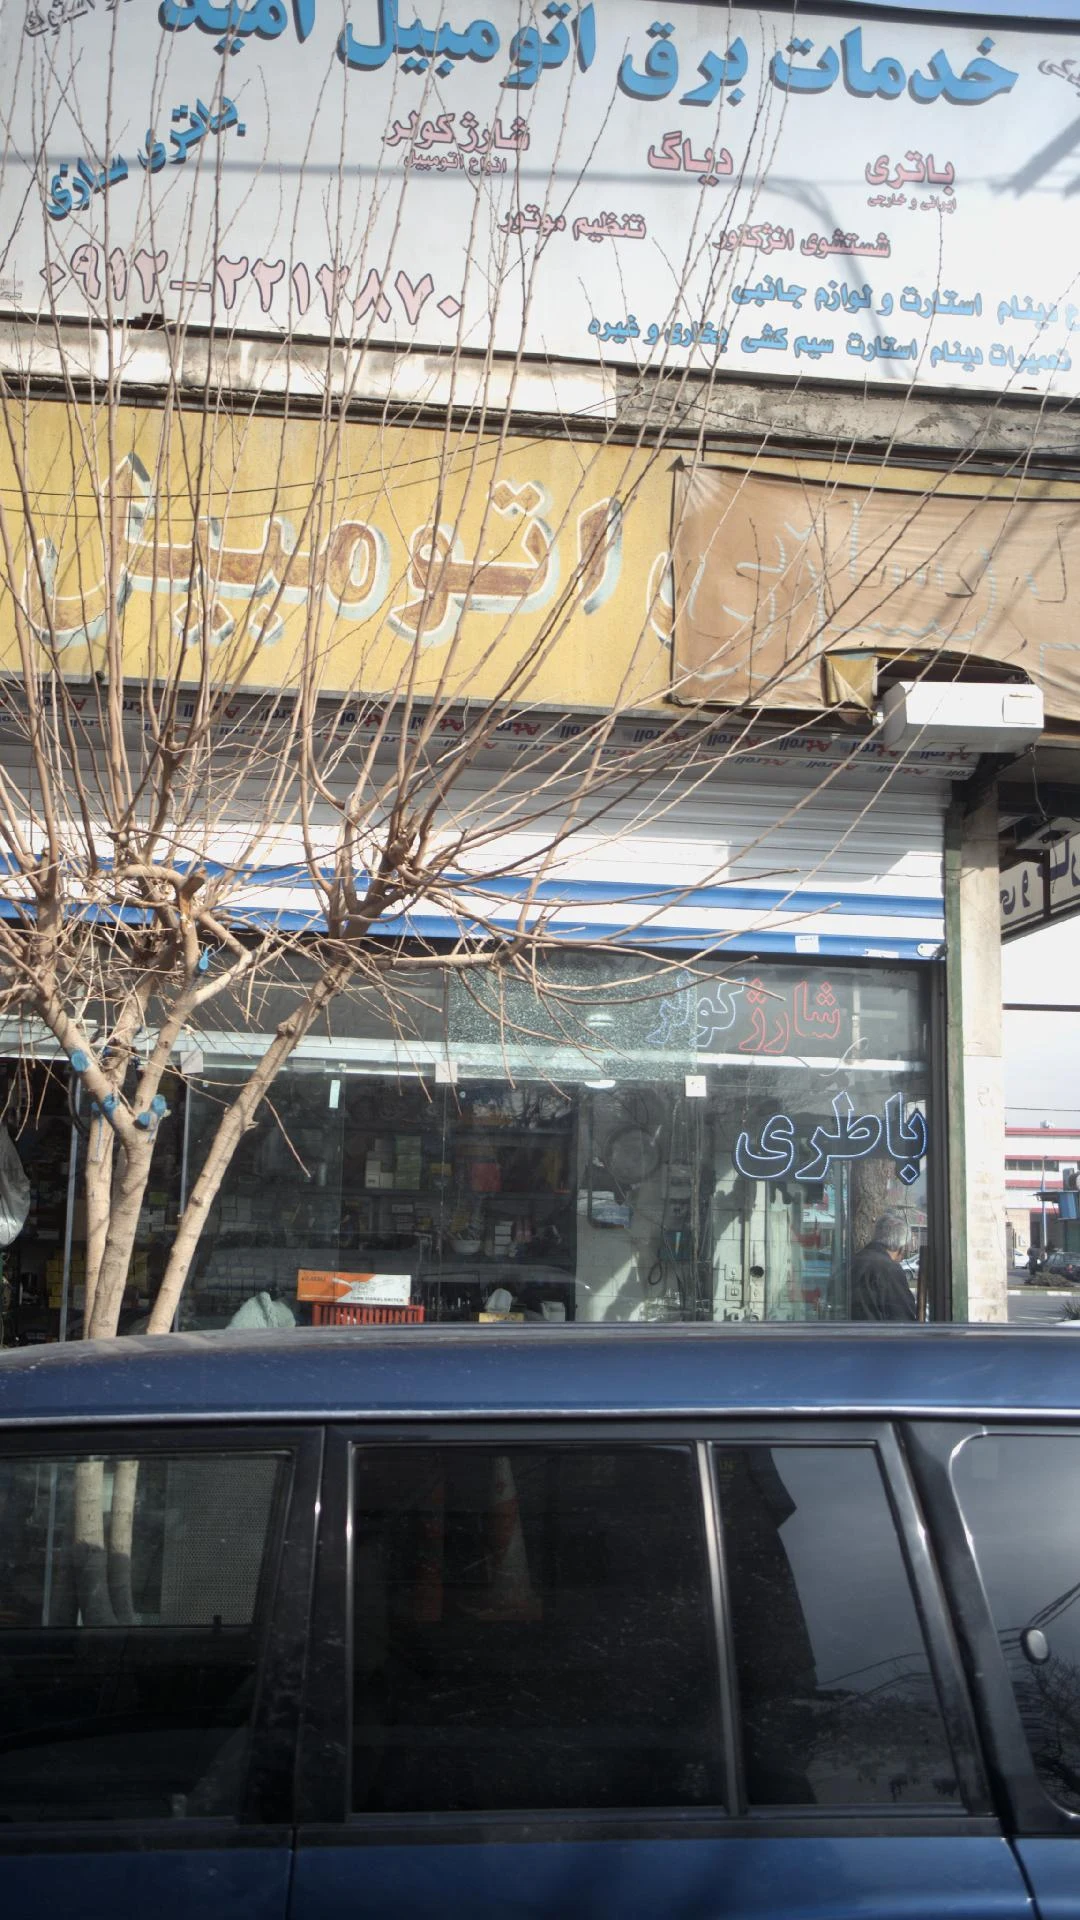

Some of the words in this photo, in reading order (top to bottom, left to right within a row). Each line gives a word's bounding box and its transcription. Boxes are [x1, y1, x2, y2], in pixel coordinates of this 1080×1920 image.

[337, 0, 597, 88] اتومبیل
[617, 20, 749, 107] برق
[771, 26, 1019, 105] خدمات
[137, 96, 246, 173] باتری
[382, 110, 455, 150] کولر
[457, 111, 530, 155] شارژ
[404, 150, 464, 173] اتومبیل
[468, 156, 507, 176] انواع
[647, 130, 734, 187] دیاگ
[864, 150, 955, 196] باتری
[46, 154, 128, 221] سازی
[867, 193, 907, 208] خارجی
[497, 204, 567, 238] موتور
[908, 198, 918, 211] و
[573, 211, 646, 243] تنظیم
[712, 222, 795, 255] انژکتور
[800, 228, 891, 259] شستشوی
[731, 274, 806, 309] جانبی
[815, 279, 873, 314] لوازم
[876, 292, 893, 316] و
[900, 286, 982, 318] استارت
[998, 294, 1058, 330] دینام
[588, 314, 640, 344] غیره
[643, 323, 660, 345] و
[665, 321, 728, 353] بخاری
[741, 323, 788, 354] کشی
[793, 335, 834, 360] سیم
[846, 332, 918, 361] استارت
[930, 340, 984, 371] دینام
[988, 343, 1072, 376] تعمیرات
[22, 452, 622, 648] اتومبیل
[646, 970, 746, 1047] کولر
[738, 978, 841, 1054] شارژ
[735, 1091, 928, 1185] باطری
